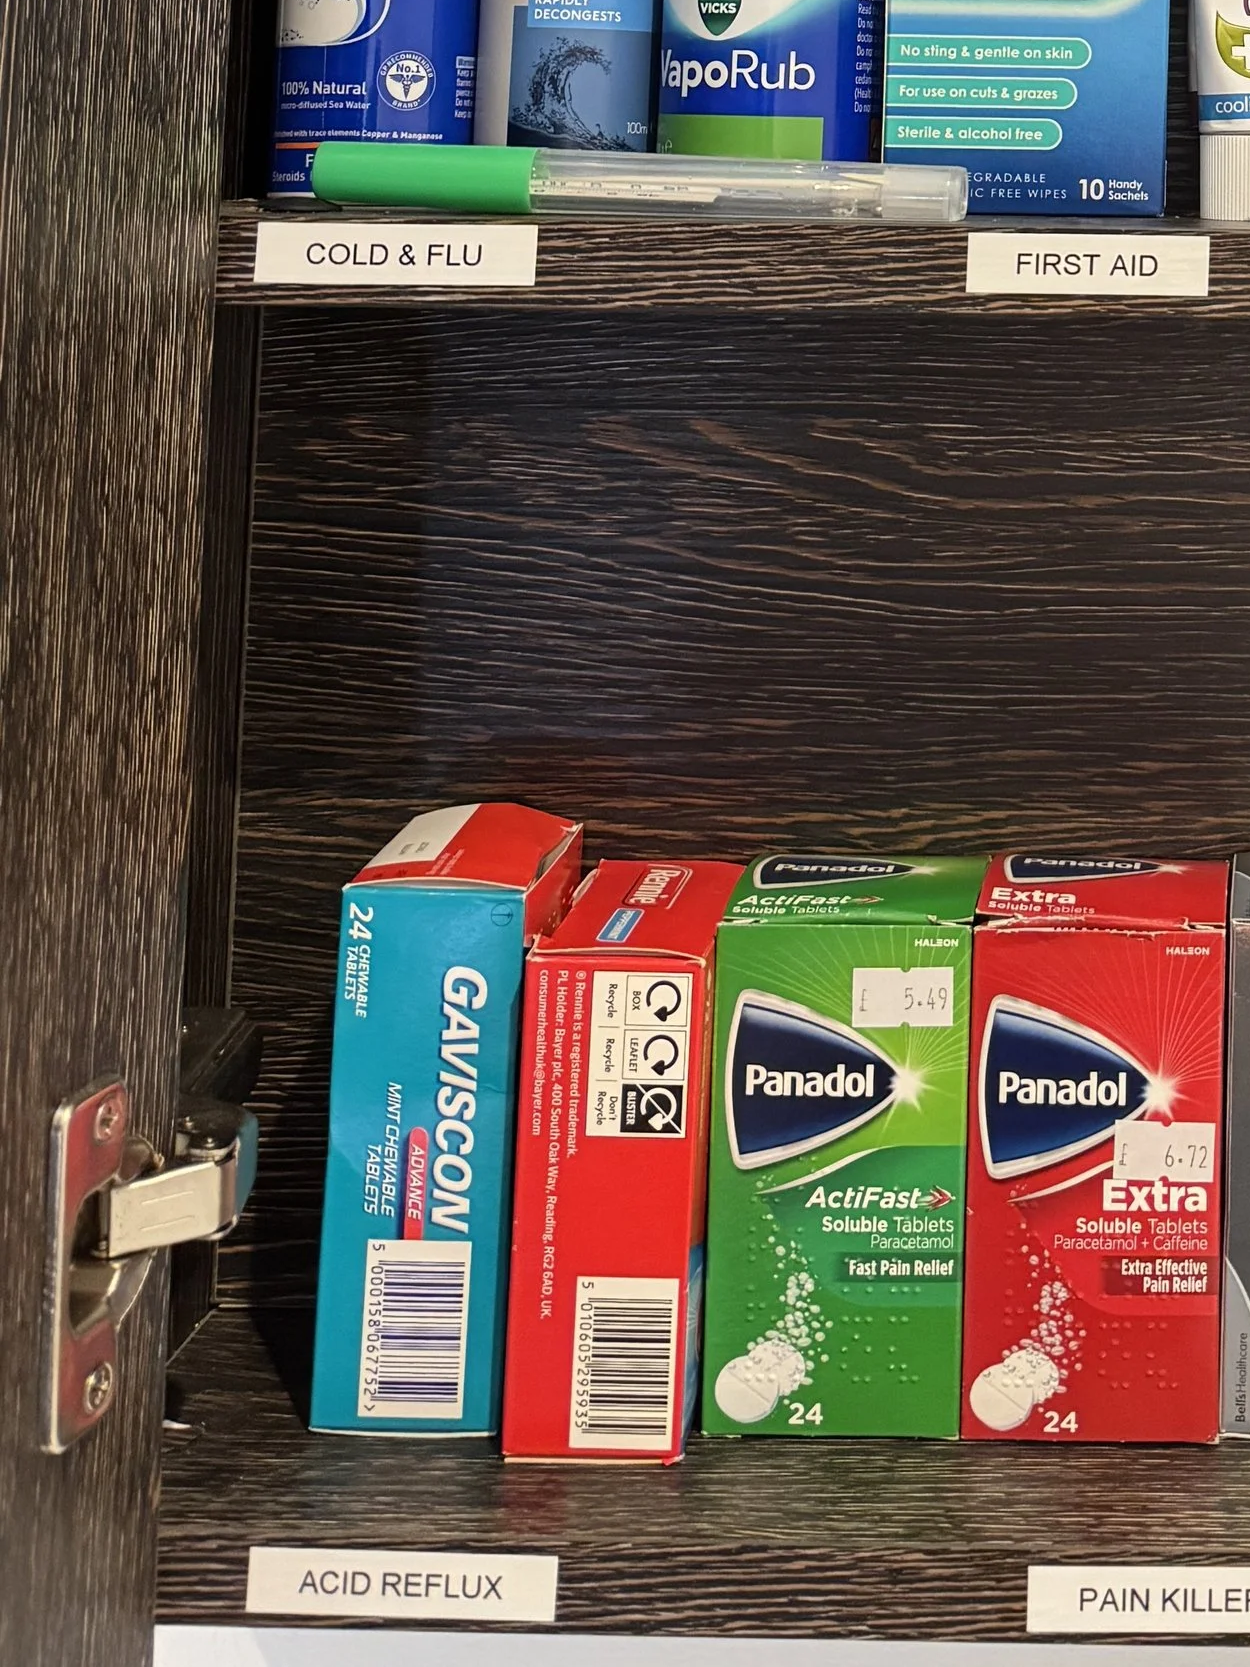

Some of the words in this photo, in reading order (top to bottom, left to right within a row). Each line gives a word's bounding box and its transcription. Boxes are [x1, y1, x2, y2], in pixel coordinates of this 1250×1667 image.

[534, 8, 622, 23] DECONGESTS
[700, 2, 737, 14] VICKS
[661, 49, 816, 98] VapoRub
[899, 85, 920, 97] For
[923, 88, 946, 98] use
[1013, 89, 1058, 102] grazes
[990, 188, 1021, 198] FREE
[1027, 189, 1067, 199] WIPES
[1078, 178, 1105, 201] 10
[1108, 190, 1149, 201] Sachets
[306, 242, 389, 266] COLD
[399, 243, 416, 267] &
[427, 243, 483, 267] FLU
[1016, 253, 1100, 276] FIRST
[1109, 254, 1159, 277] AID
[624, 868, 682, 905] Rennie
[348, 902, 374, 940] 24
[355, 944, 371, 1018] CHEWABLE
[904, 987, 948, 1011] 5.49
[745, 1064, 874, 1097] Panadol
[998, 1071, 1127, 1107] Panadol
[430, 965, 489, 1234] GAVISCON
[1164, 1144, 1208, 1169] 6.72
[407, 1144, 426, 1221] ADVANCE
[1102, 1178, 1208, 1212] Extra
[805, 1185, 922, 1209] ActiFast
[822, 1216, 888, 1233] Soluble
[893, 1217, 954, 1232] Tablets
[870, 1234, 954, 1250] Paracetamol
[1053, 1234, 1137, 1251] Paracetamol
[1153, 1234, 1208, 1251] Caffeine
[849, 1259, 877, 1276] Fast
[880, 1259, 910, 1276] Pain
[914, 1259, 955, 1276] Relief
[578, 1303, 593, 1363] 010605
[575, 1368, 590, 1429] 295935
[787, 1402, 824, 1426] 24
[297, 1569, 371, 1595] ACID
[381, 1571, 503, 1600] REFLUX
[1079, 1587, 1150, 1613] PAIN
